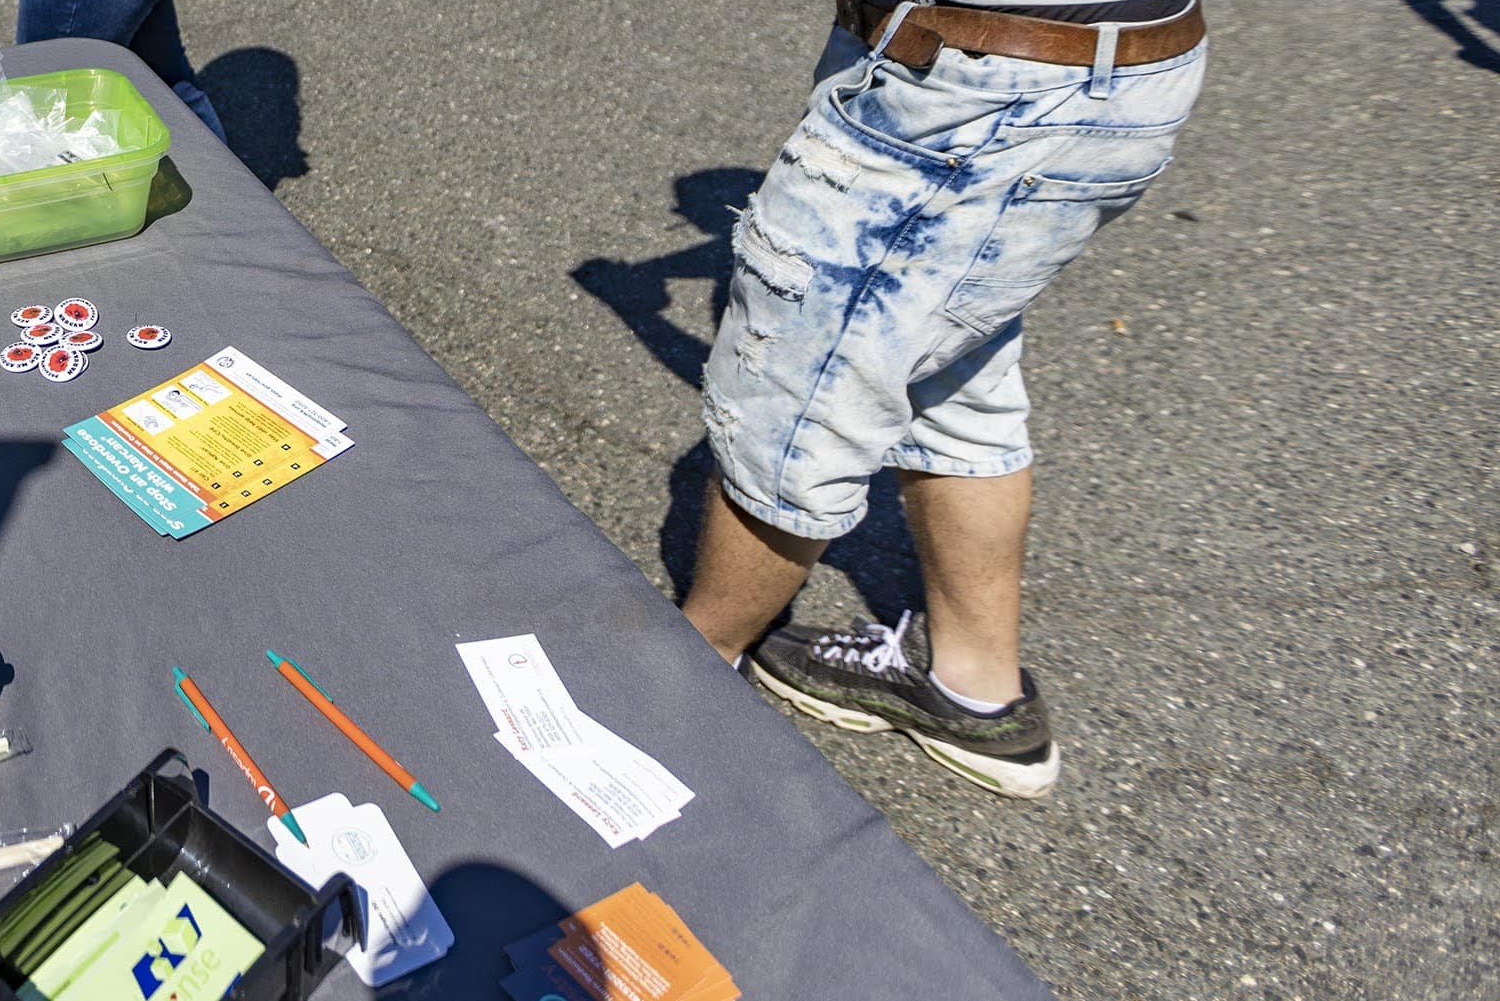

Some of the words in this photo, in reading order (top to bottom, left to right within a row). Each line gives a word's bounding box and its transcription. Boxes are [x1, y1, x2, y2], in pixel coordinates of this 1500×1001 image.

[75, 427, 131, 476] Overdose
[129, 473, 147, 487] an
[146, 469, 175, 495] with
[145, 483, 177, 511] Stop
